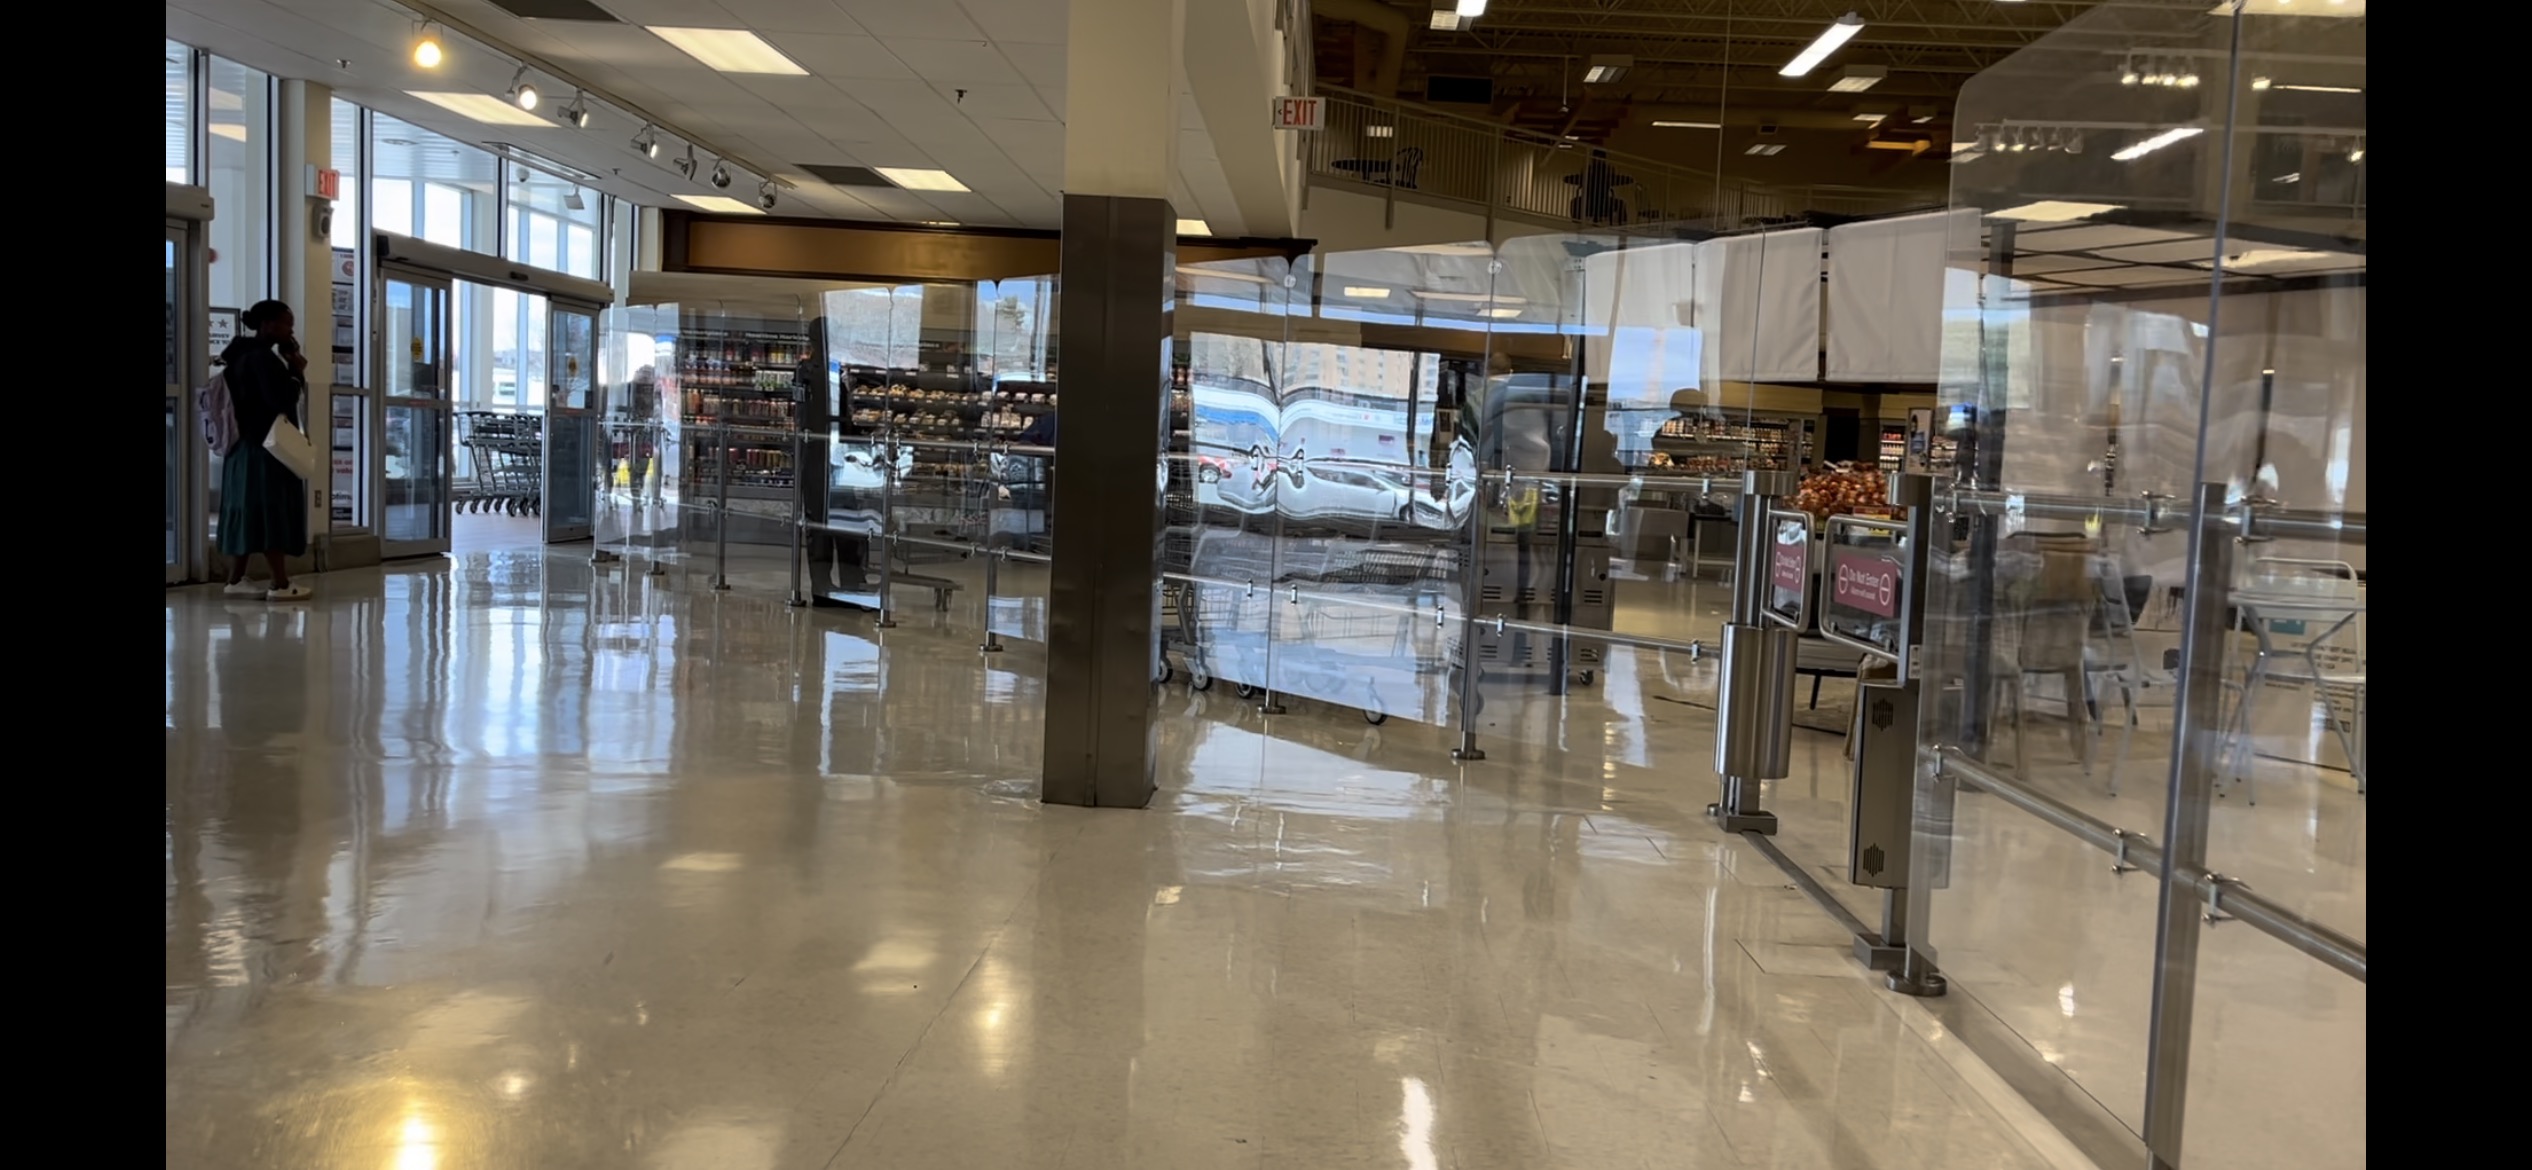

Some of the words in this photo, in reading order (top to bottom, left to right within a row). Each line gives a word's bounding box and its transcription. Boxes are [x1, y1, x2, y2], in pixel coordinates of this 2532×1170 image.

[1283, 99, 1317, 126] EXIT
[318, 170, 336, 198] EXIT
[1849, 568, 1856, 582] Do
[1857, 570, 1865, 585] Not
[1866, 572, 1880, 588] Enter
